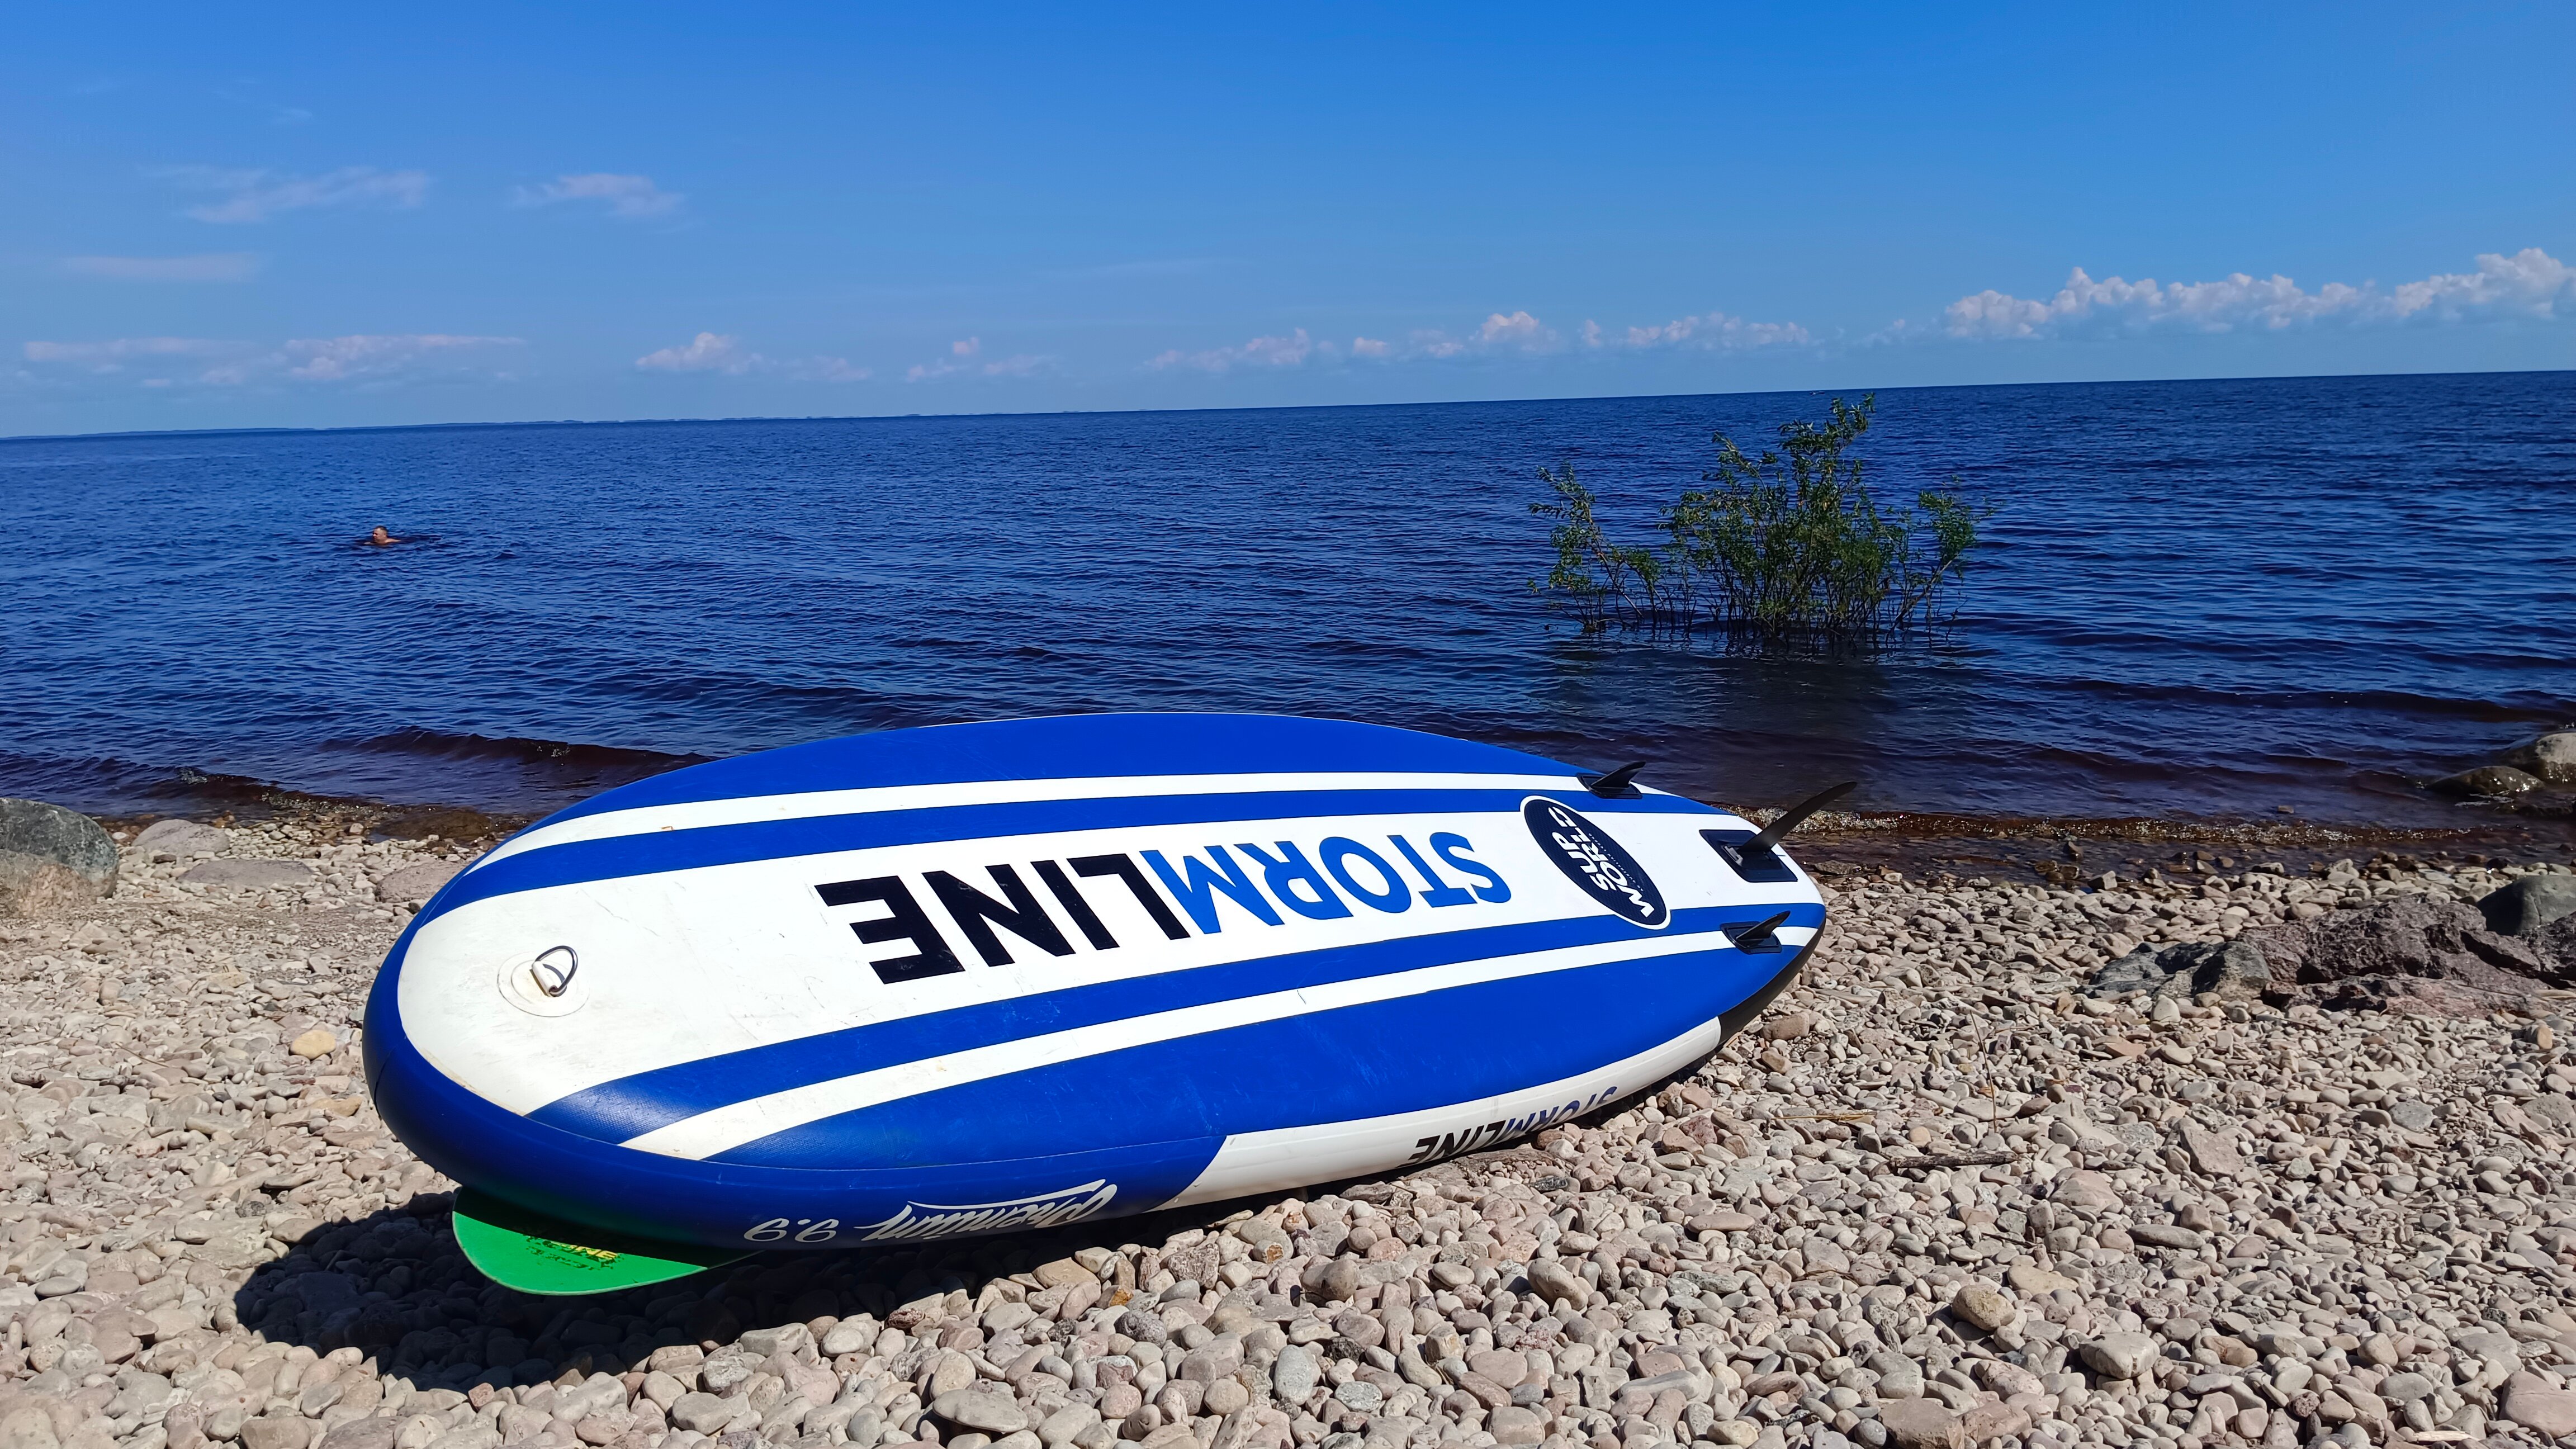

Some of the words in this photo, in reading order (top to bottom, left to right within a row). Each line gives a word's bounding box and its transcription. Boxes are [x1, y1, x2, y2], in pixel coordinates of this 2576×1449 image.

[1548, 806, 1655, 918] WORLD
[1552, 832, 1617, 891] SUP
[814, 832, 1512, 984] STORMLINE
[744, 1218, 839, 1242] 9.9
[854, 1179, 1117, 1241] Premium
